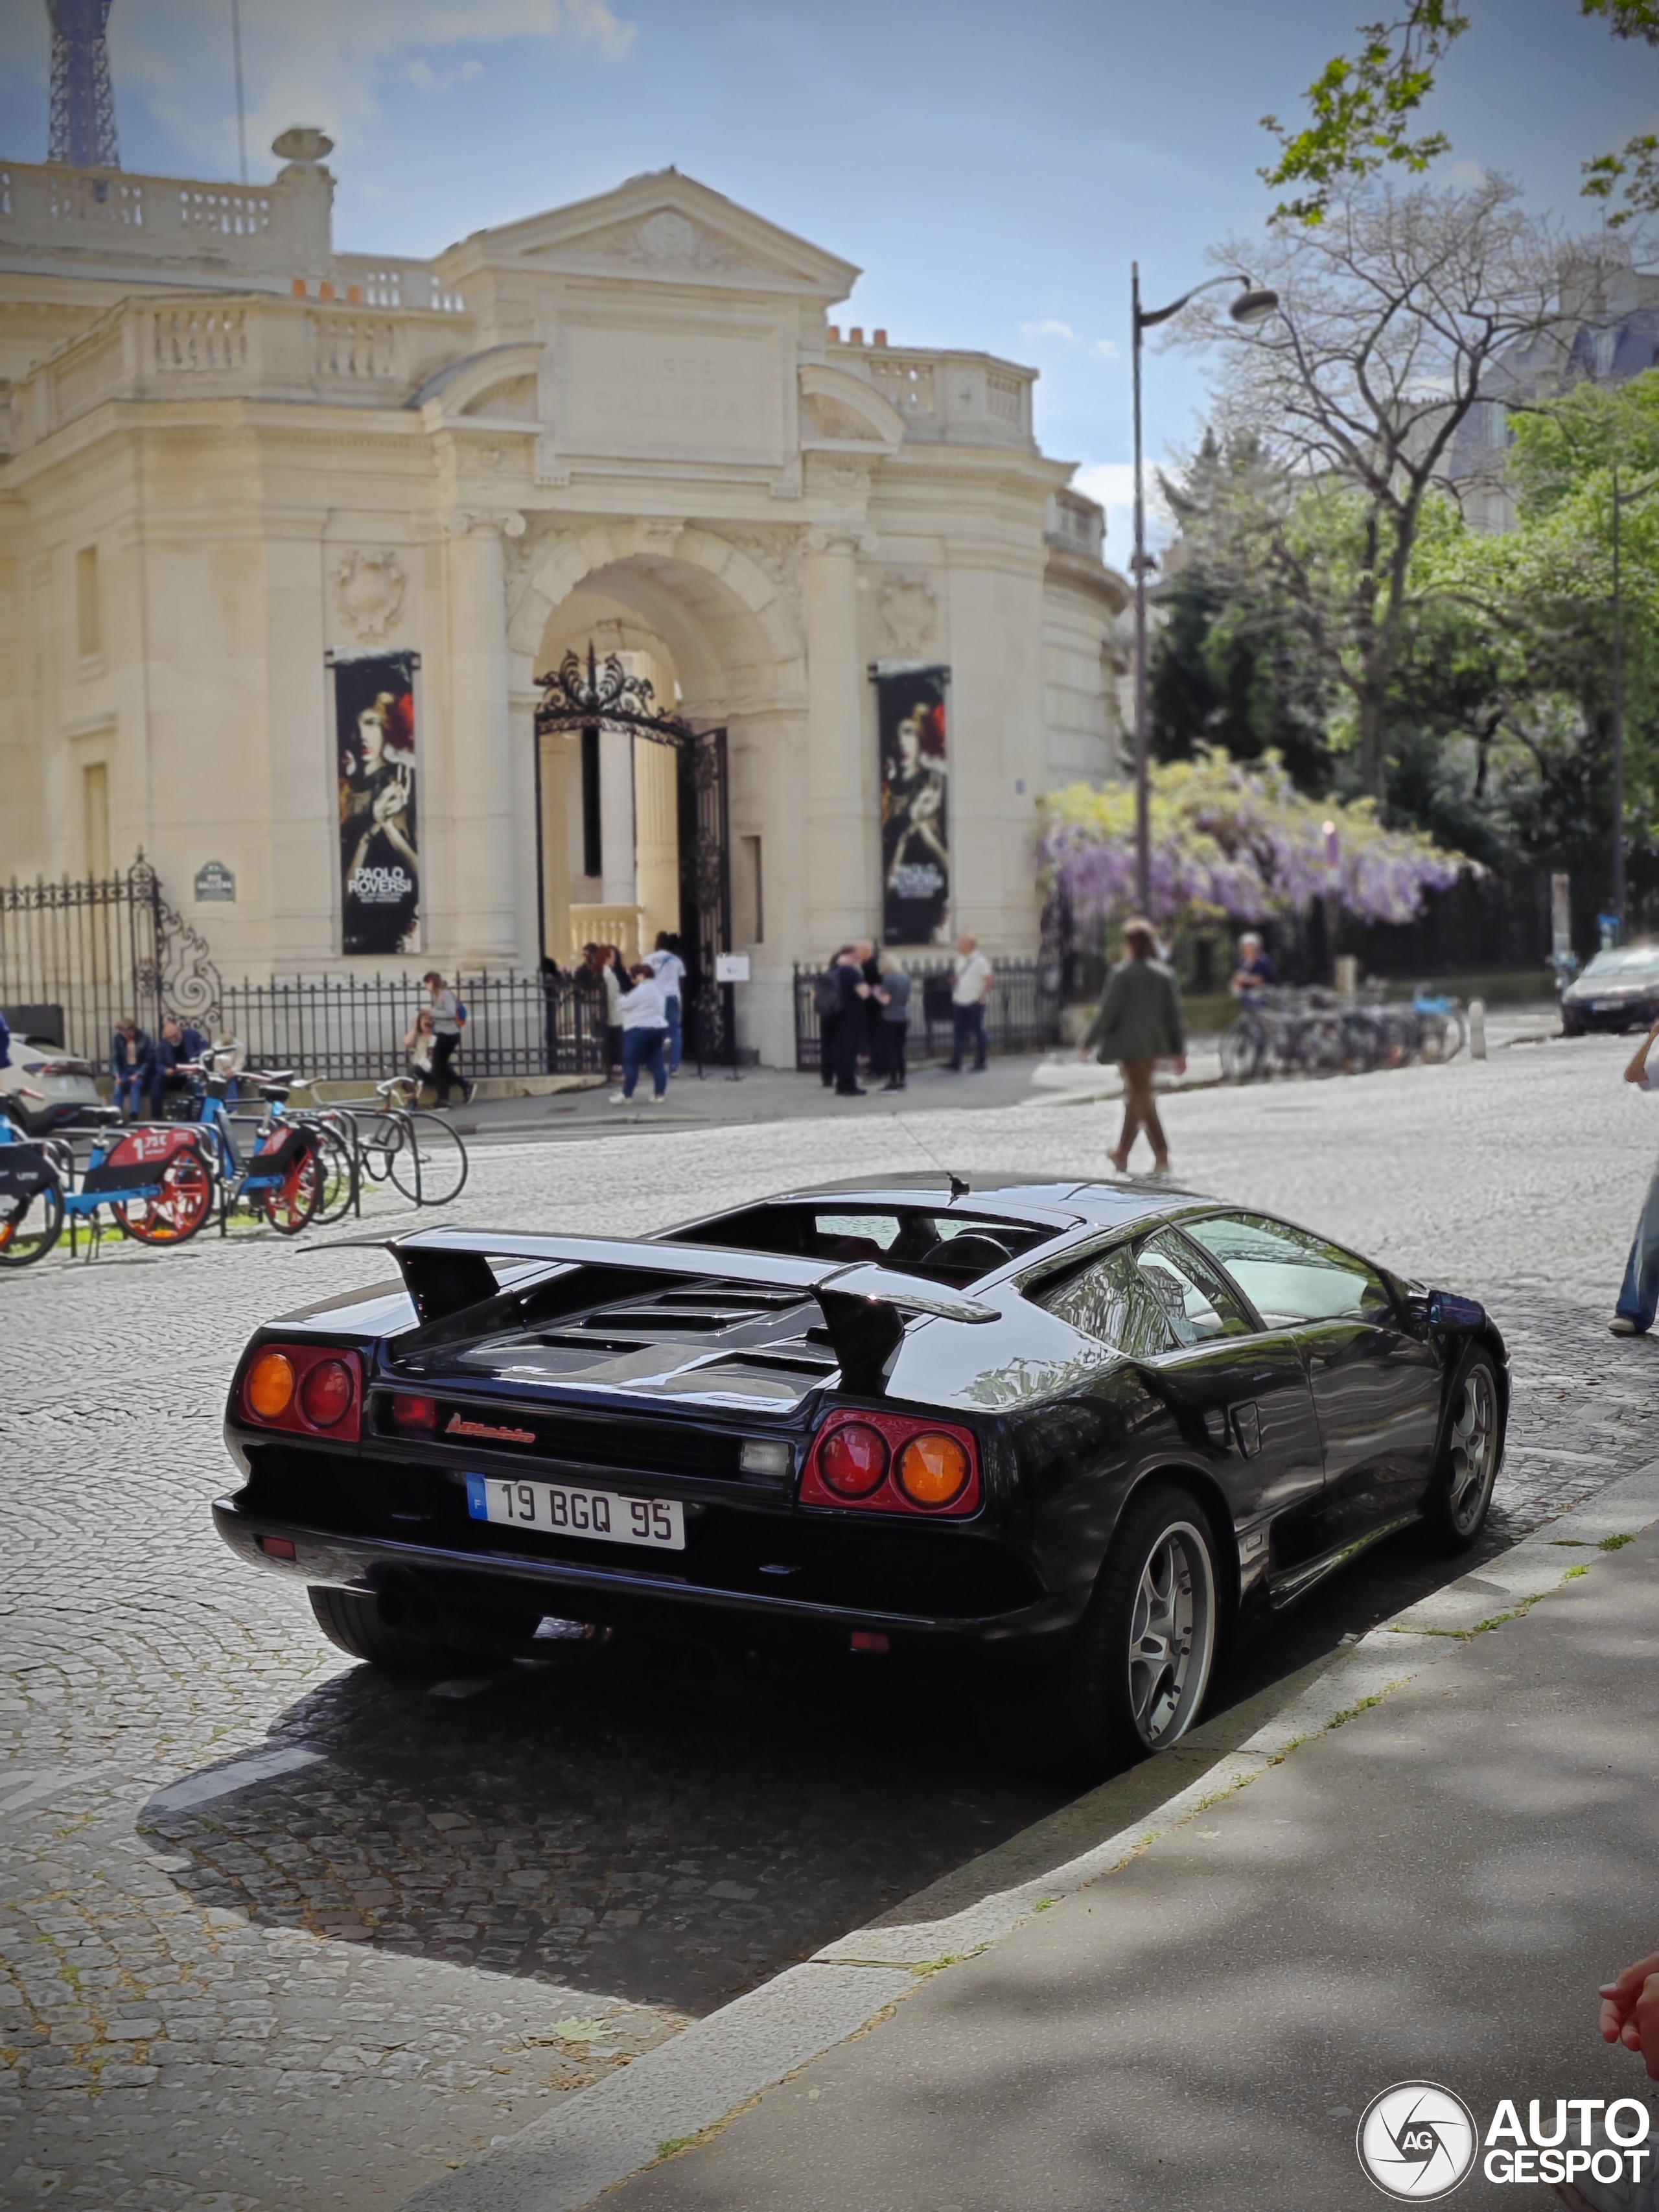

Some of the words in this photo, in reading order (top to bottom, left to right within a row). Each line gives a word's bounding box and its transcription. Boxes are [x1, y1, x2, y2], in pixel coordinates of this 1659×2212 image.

[355, 866, 404, 880] PAOLO
[348, 878, 412, 893] ROVERSI
[474, 1499, 481, 1509] F
[502, 1484, 535, 1522] 19
[550, 1490, 611, 1533] BGQ
[631, 1502, 672, 1540] 95
